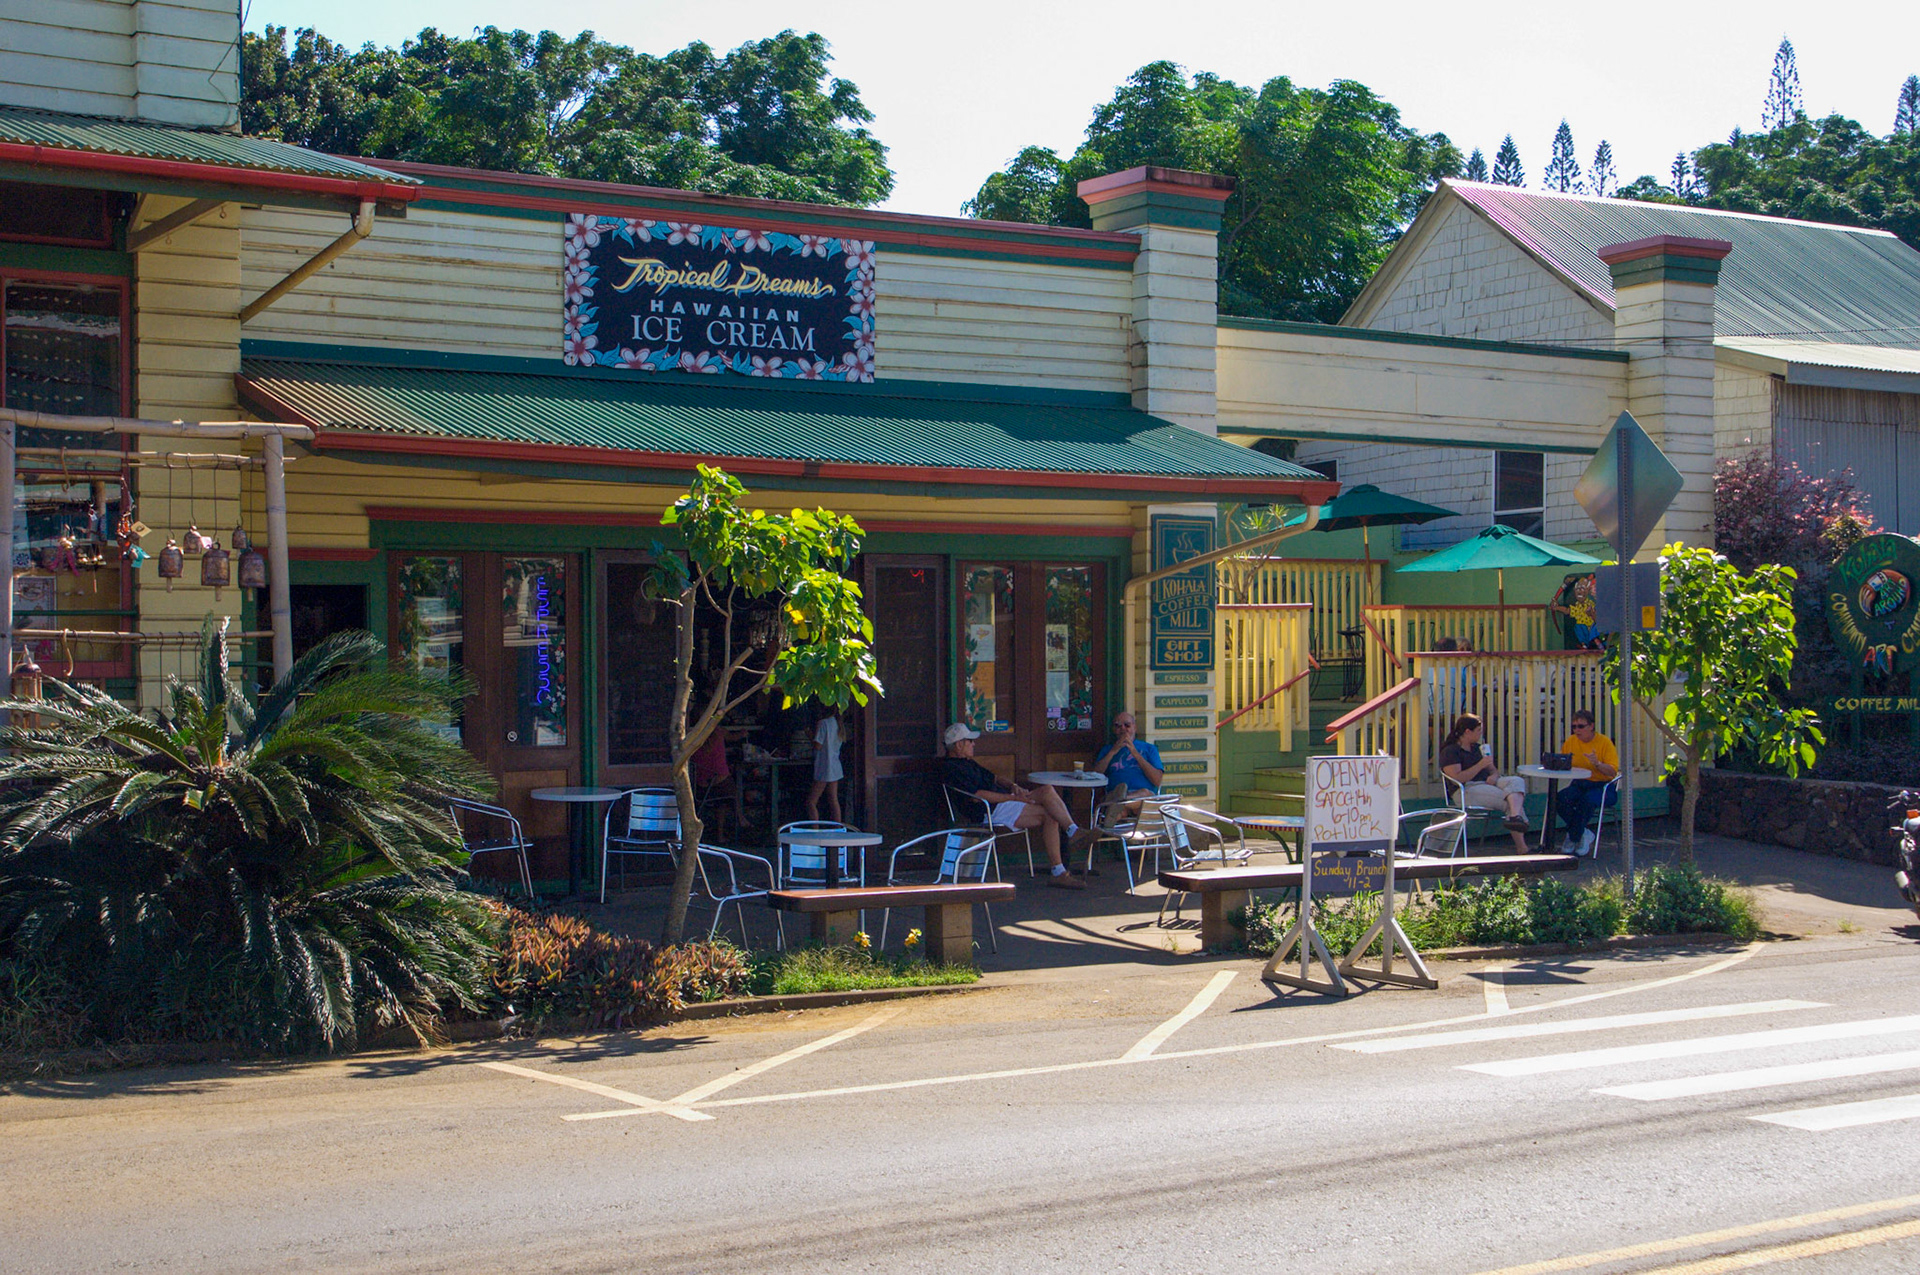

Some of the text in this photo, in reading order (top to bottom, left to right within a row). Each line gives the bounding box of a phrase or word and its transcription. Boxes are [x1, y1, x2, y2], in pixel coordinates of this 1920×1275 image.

[610, 255, 836, 298] Tropical Dreams
[650, 299, 800, 323] HAWAIIAN
[630, 314, 817, 353] ICE CREAM
[1162, 579, 1206, 600] KOHALA
[1873, 577, 1906, 617] AROUND
[1158, 595, 1209, 615] COFFEE
[1170, 609, 1202, 628] MILL
[1166, 640, 1201, 651] GIFT
[1163, 650, 1204, 662] SHOP
[1862, 643, 1898, 678] ART
[1164, 674, 1200, 683] ESPRESSO
[1161, 697, 1203, 706] CAPPUCCINO
[1834, 697, 1892, 711] COFFEE
[1158, 718, 1205, 727] KONA COFFEE
[1171, 741, 1192, 750] GIFTS
[1163, 763, 1205, 772] OFT DRINKS
[1165, 786, 1198, 795] PASTRIES
[1313, 858, 1388, 882] Sunday Brunch
[1347, 876, 1372, 889] 11-2
